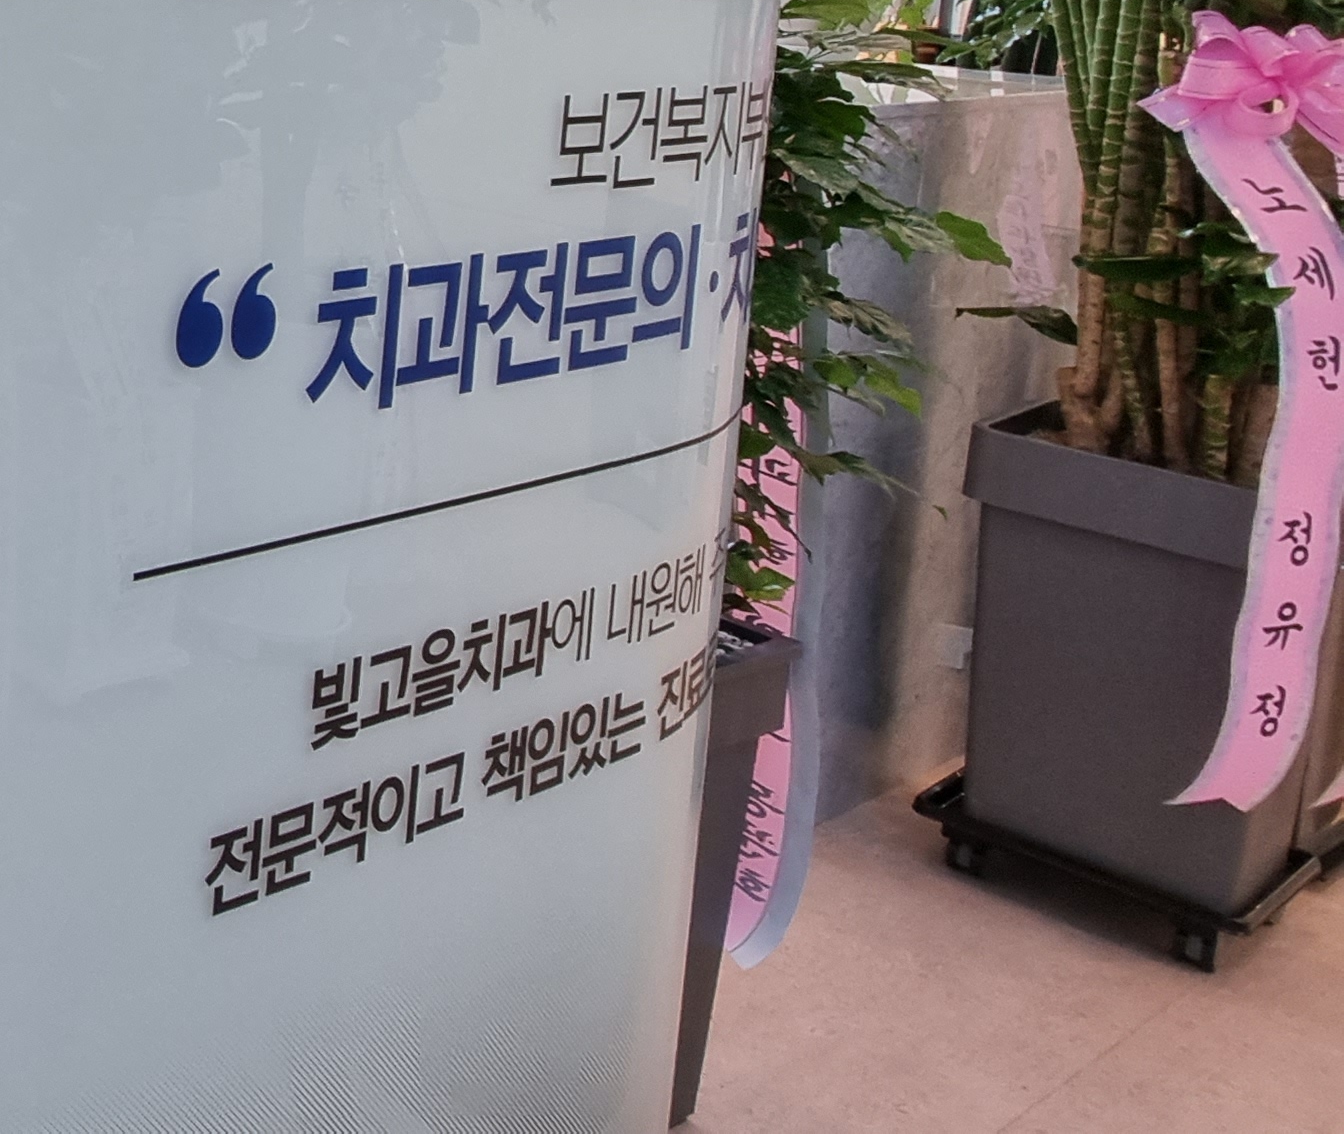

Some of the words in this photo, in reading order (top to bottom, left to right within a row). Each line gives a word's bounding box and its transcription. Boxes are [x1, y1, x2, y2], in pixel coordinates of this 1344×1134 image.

[310, 587, 597, 752] 빛고을치과에
[605, 542, 706, 645] 내원해
[204, 752, 464, 916] 전문적이고
[480, 692, 646, 803] 책임있는
